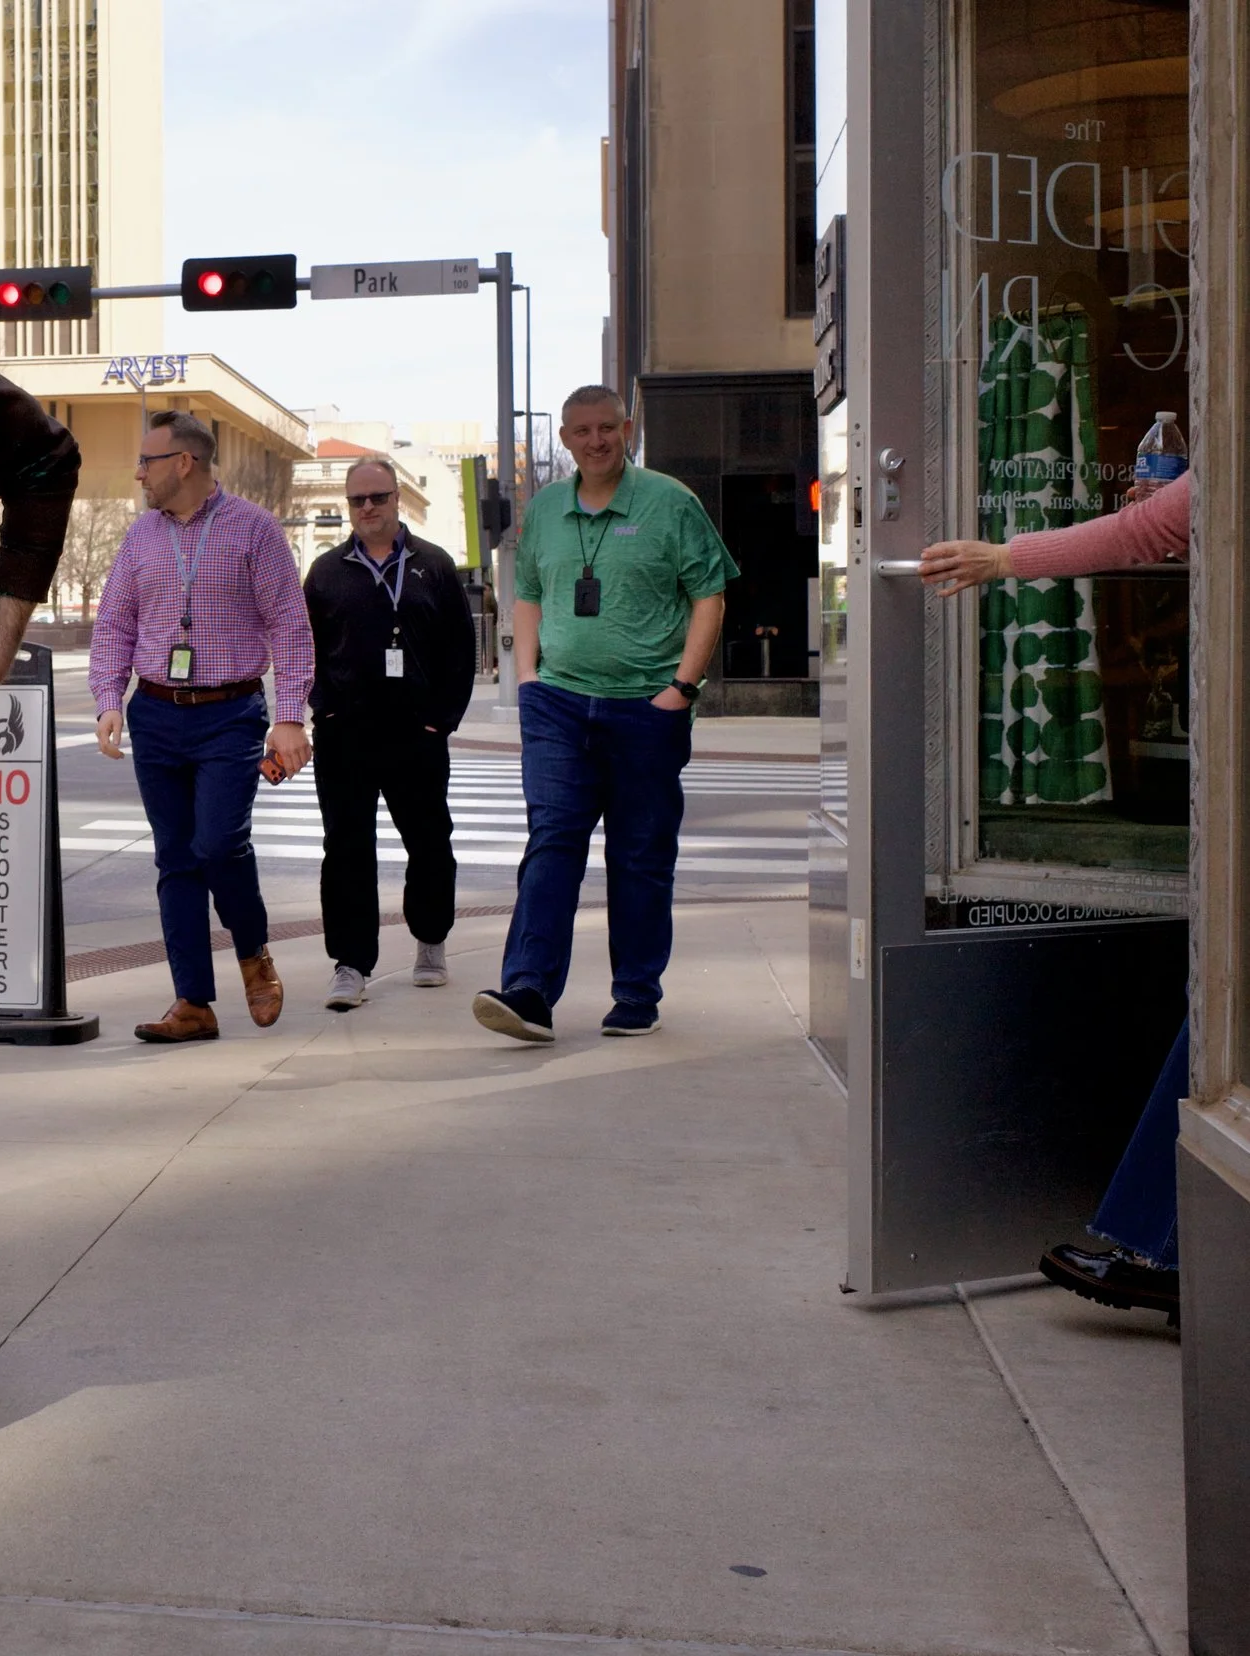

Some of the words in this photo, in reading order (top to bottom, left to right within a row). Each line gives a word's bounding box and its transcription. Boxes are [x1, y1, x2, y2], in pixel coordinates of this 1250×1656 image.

[452, 264, 469, 274] Ave
[354, 268, 398, 293] Park
[453, 279, 469, 289] 100
[104, 355, 189, 387] ARVEST
